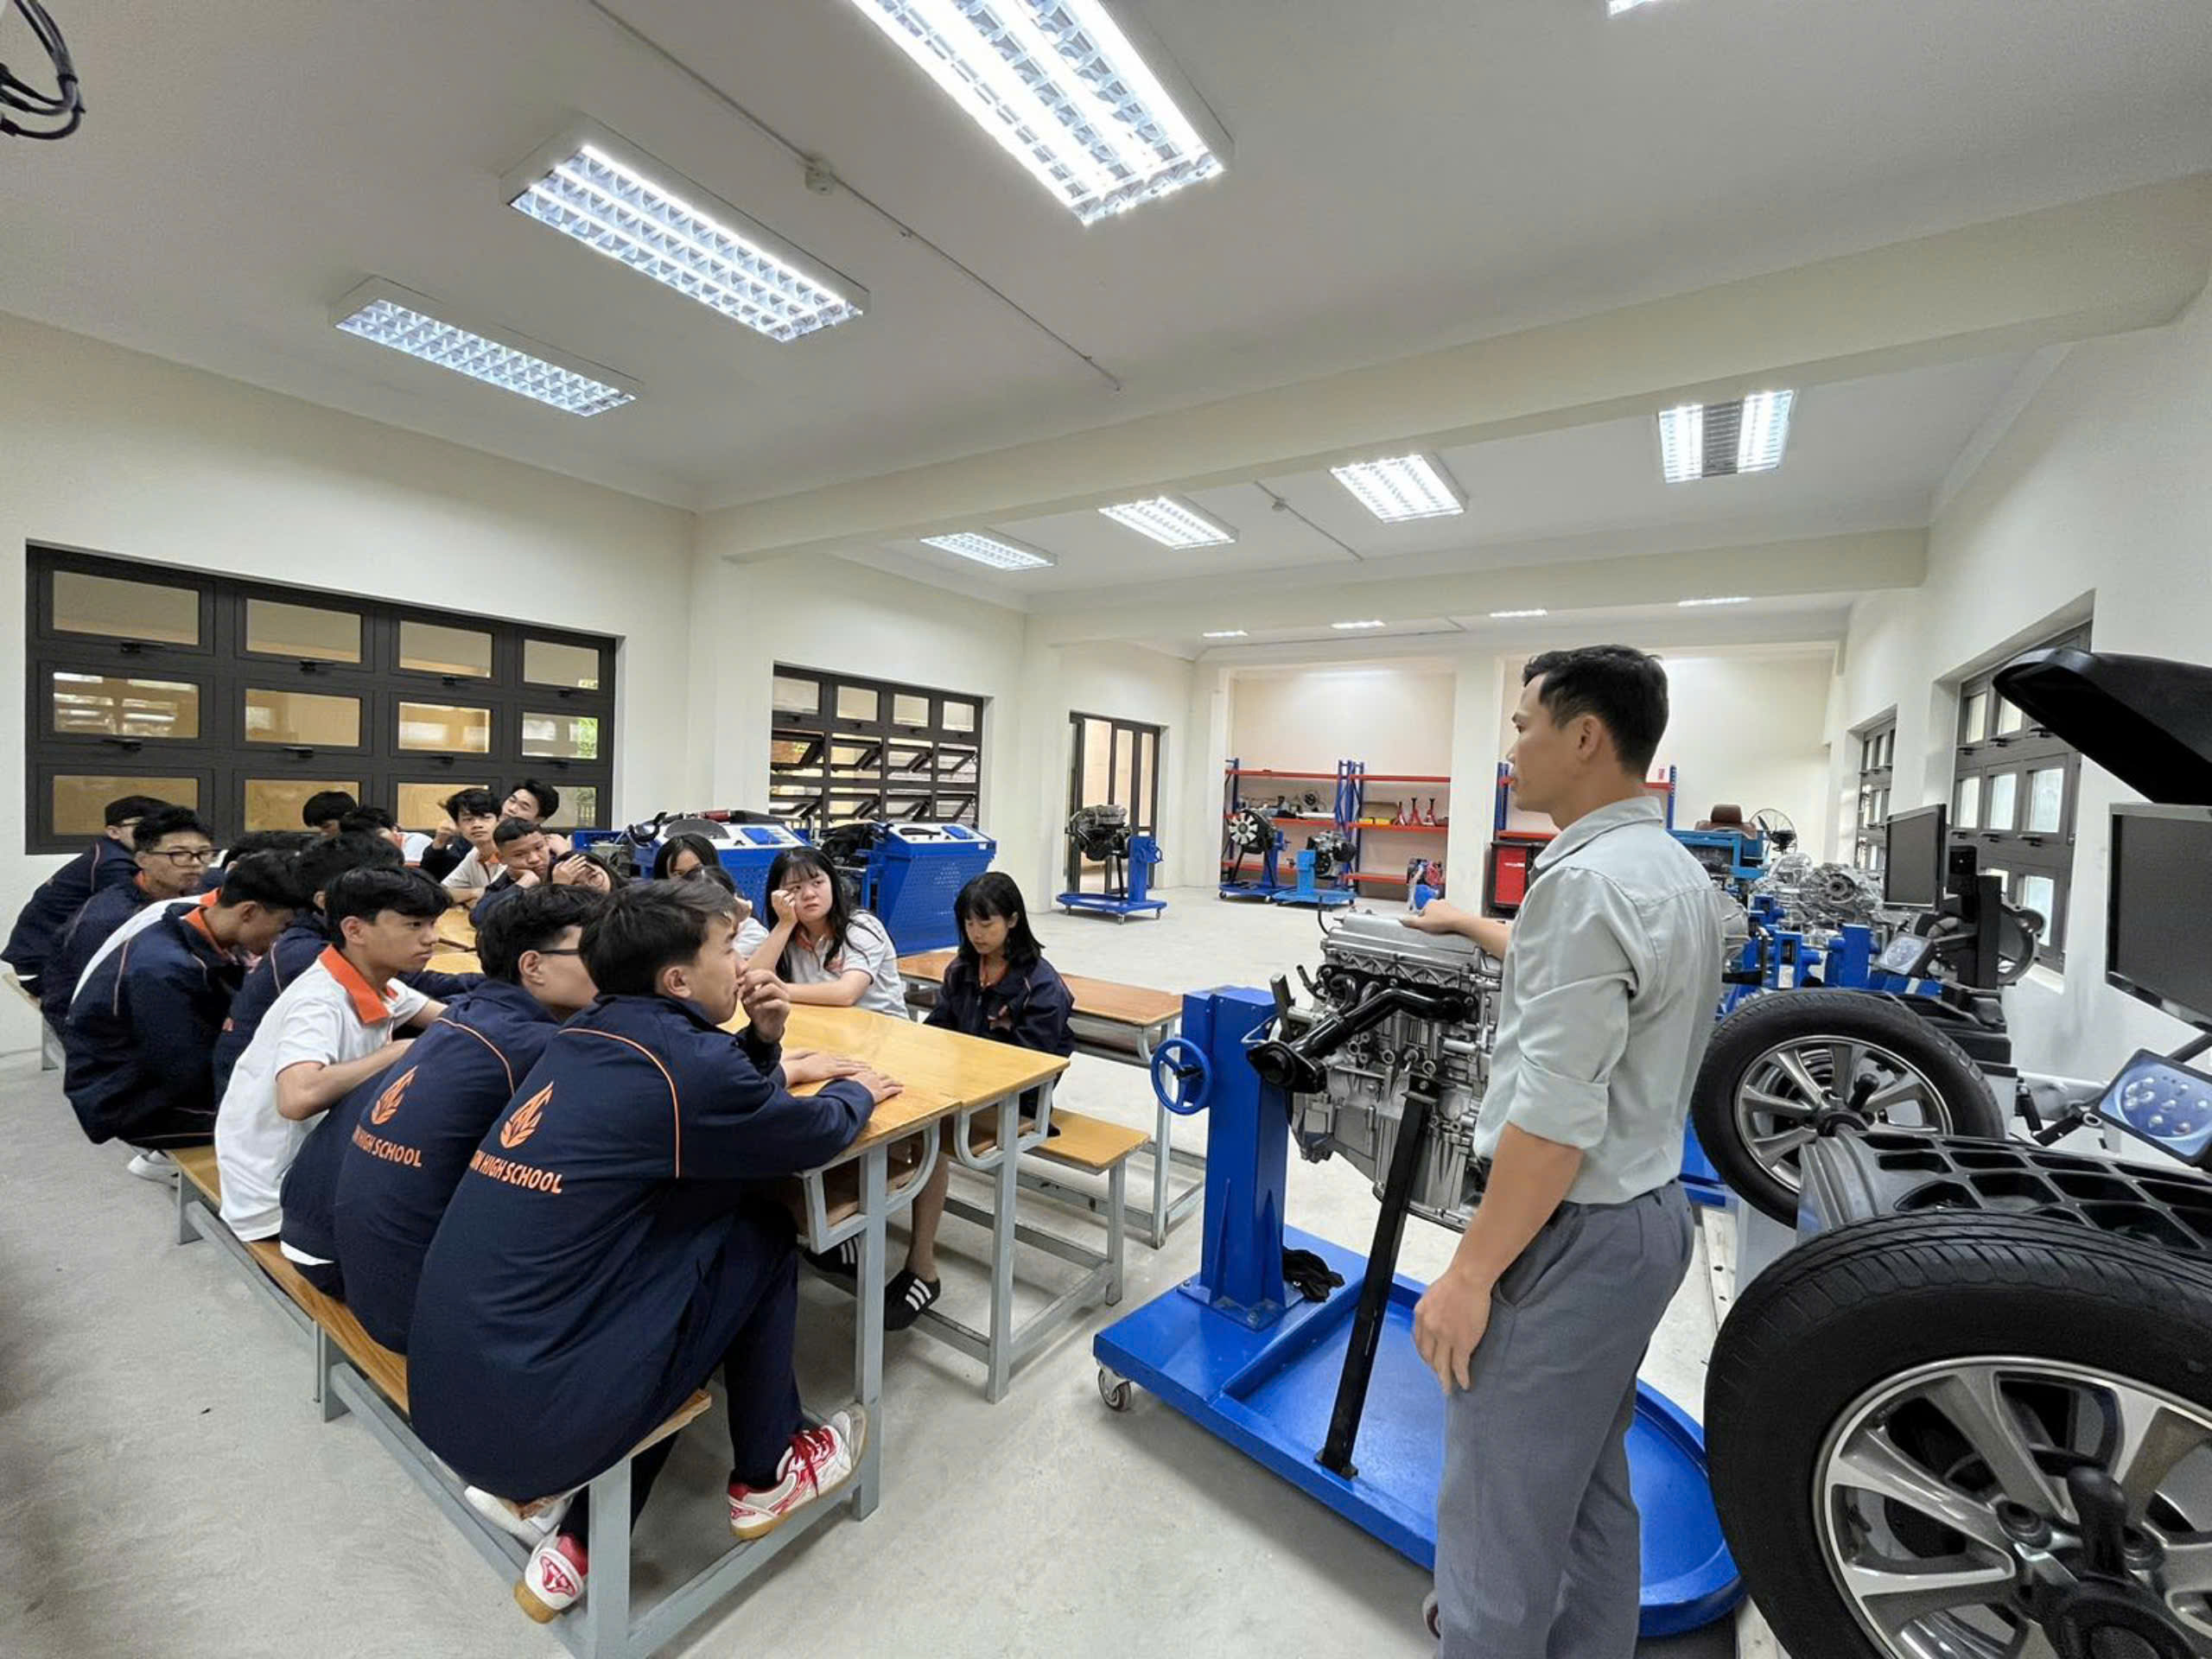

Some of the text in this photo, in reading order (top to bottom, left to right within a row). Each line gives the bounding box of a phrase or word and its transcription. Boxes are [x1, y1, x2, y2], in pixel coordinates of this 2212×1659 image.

[372, 1139, 423, 1167] SCHOOL
[479, 1154, 509, 1179] HIGH
[501, 1162, 563, 1194] SCHOOL
